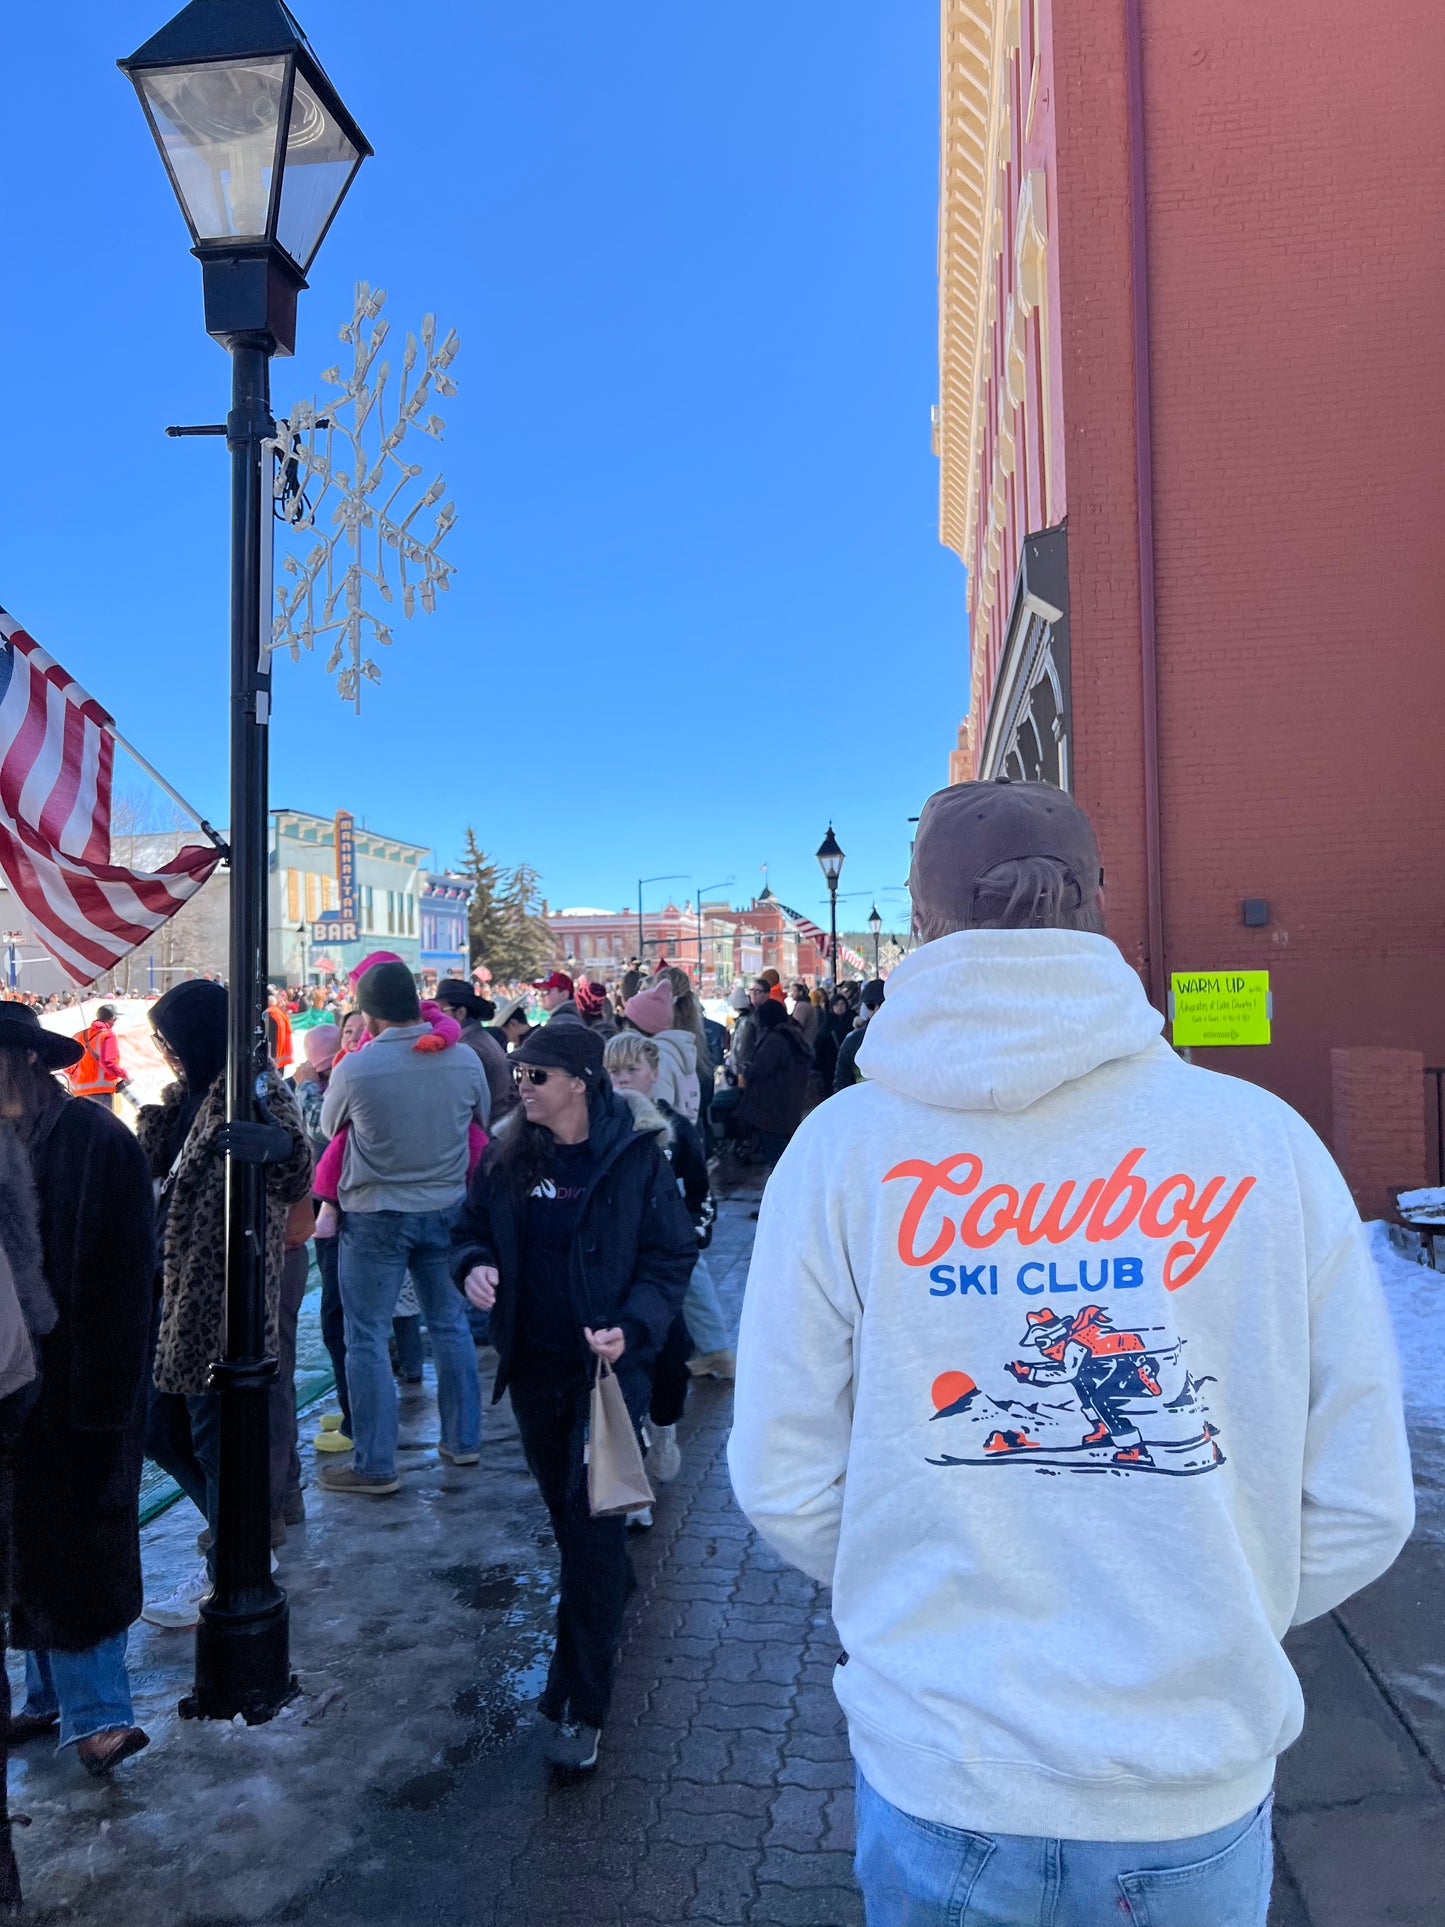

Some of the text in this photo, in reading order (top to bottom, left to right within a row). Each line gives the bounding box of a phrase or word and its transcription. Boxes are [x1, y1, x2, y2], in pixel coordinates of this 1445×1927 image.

[341, 820, 353, 918] MANHATTAN
[314, 923, 357, 941] BAR
[1177, 979, 1220, 994] WARM
[1226, 977, 1245, 993] UP
[881, 1147, 1257, 1292] Cowboy
[929, 1257, 1144, 1297] SKI CLUB
